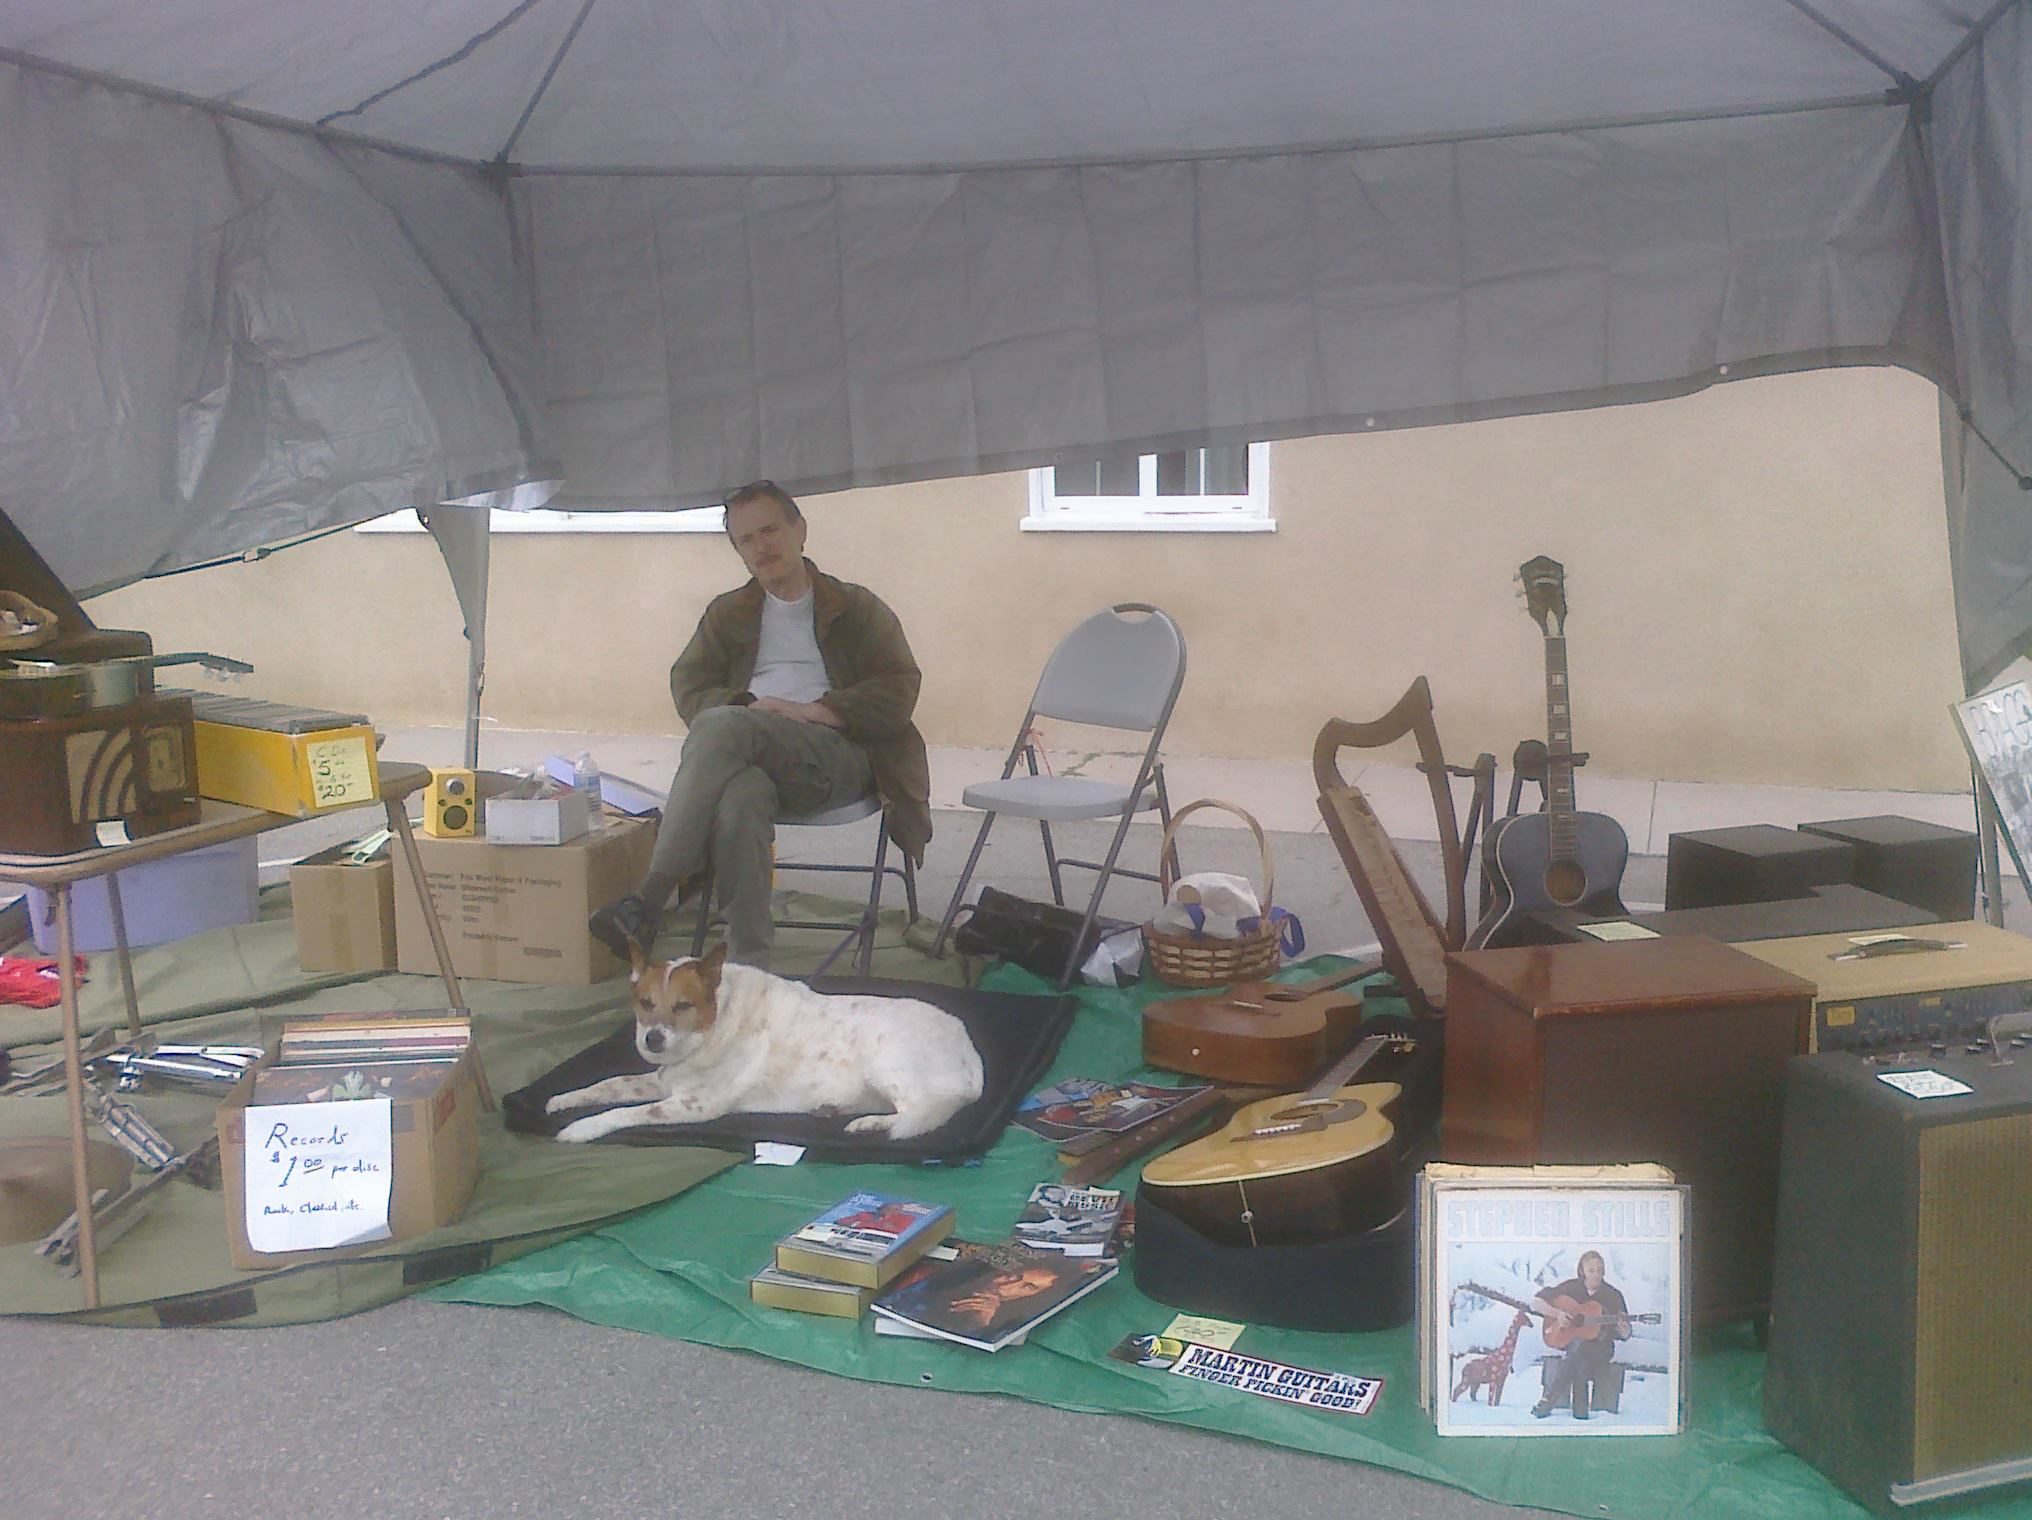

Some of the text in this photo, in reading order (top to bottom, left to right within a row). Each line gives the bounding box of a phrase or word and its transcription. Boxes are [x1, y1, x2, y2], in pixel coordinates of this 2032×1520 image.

[264, 1122, 349, 1149] Records
[1448, 1199, 1672, 1238] STEPHEN STILLS
[1178, 1363, 1243, 1387] FINGER
[1187, 1347, 1371, 1398] MARTIN GUITARS
